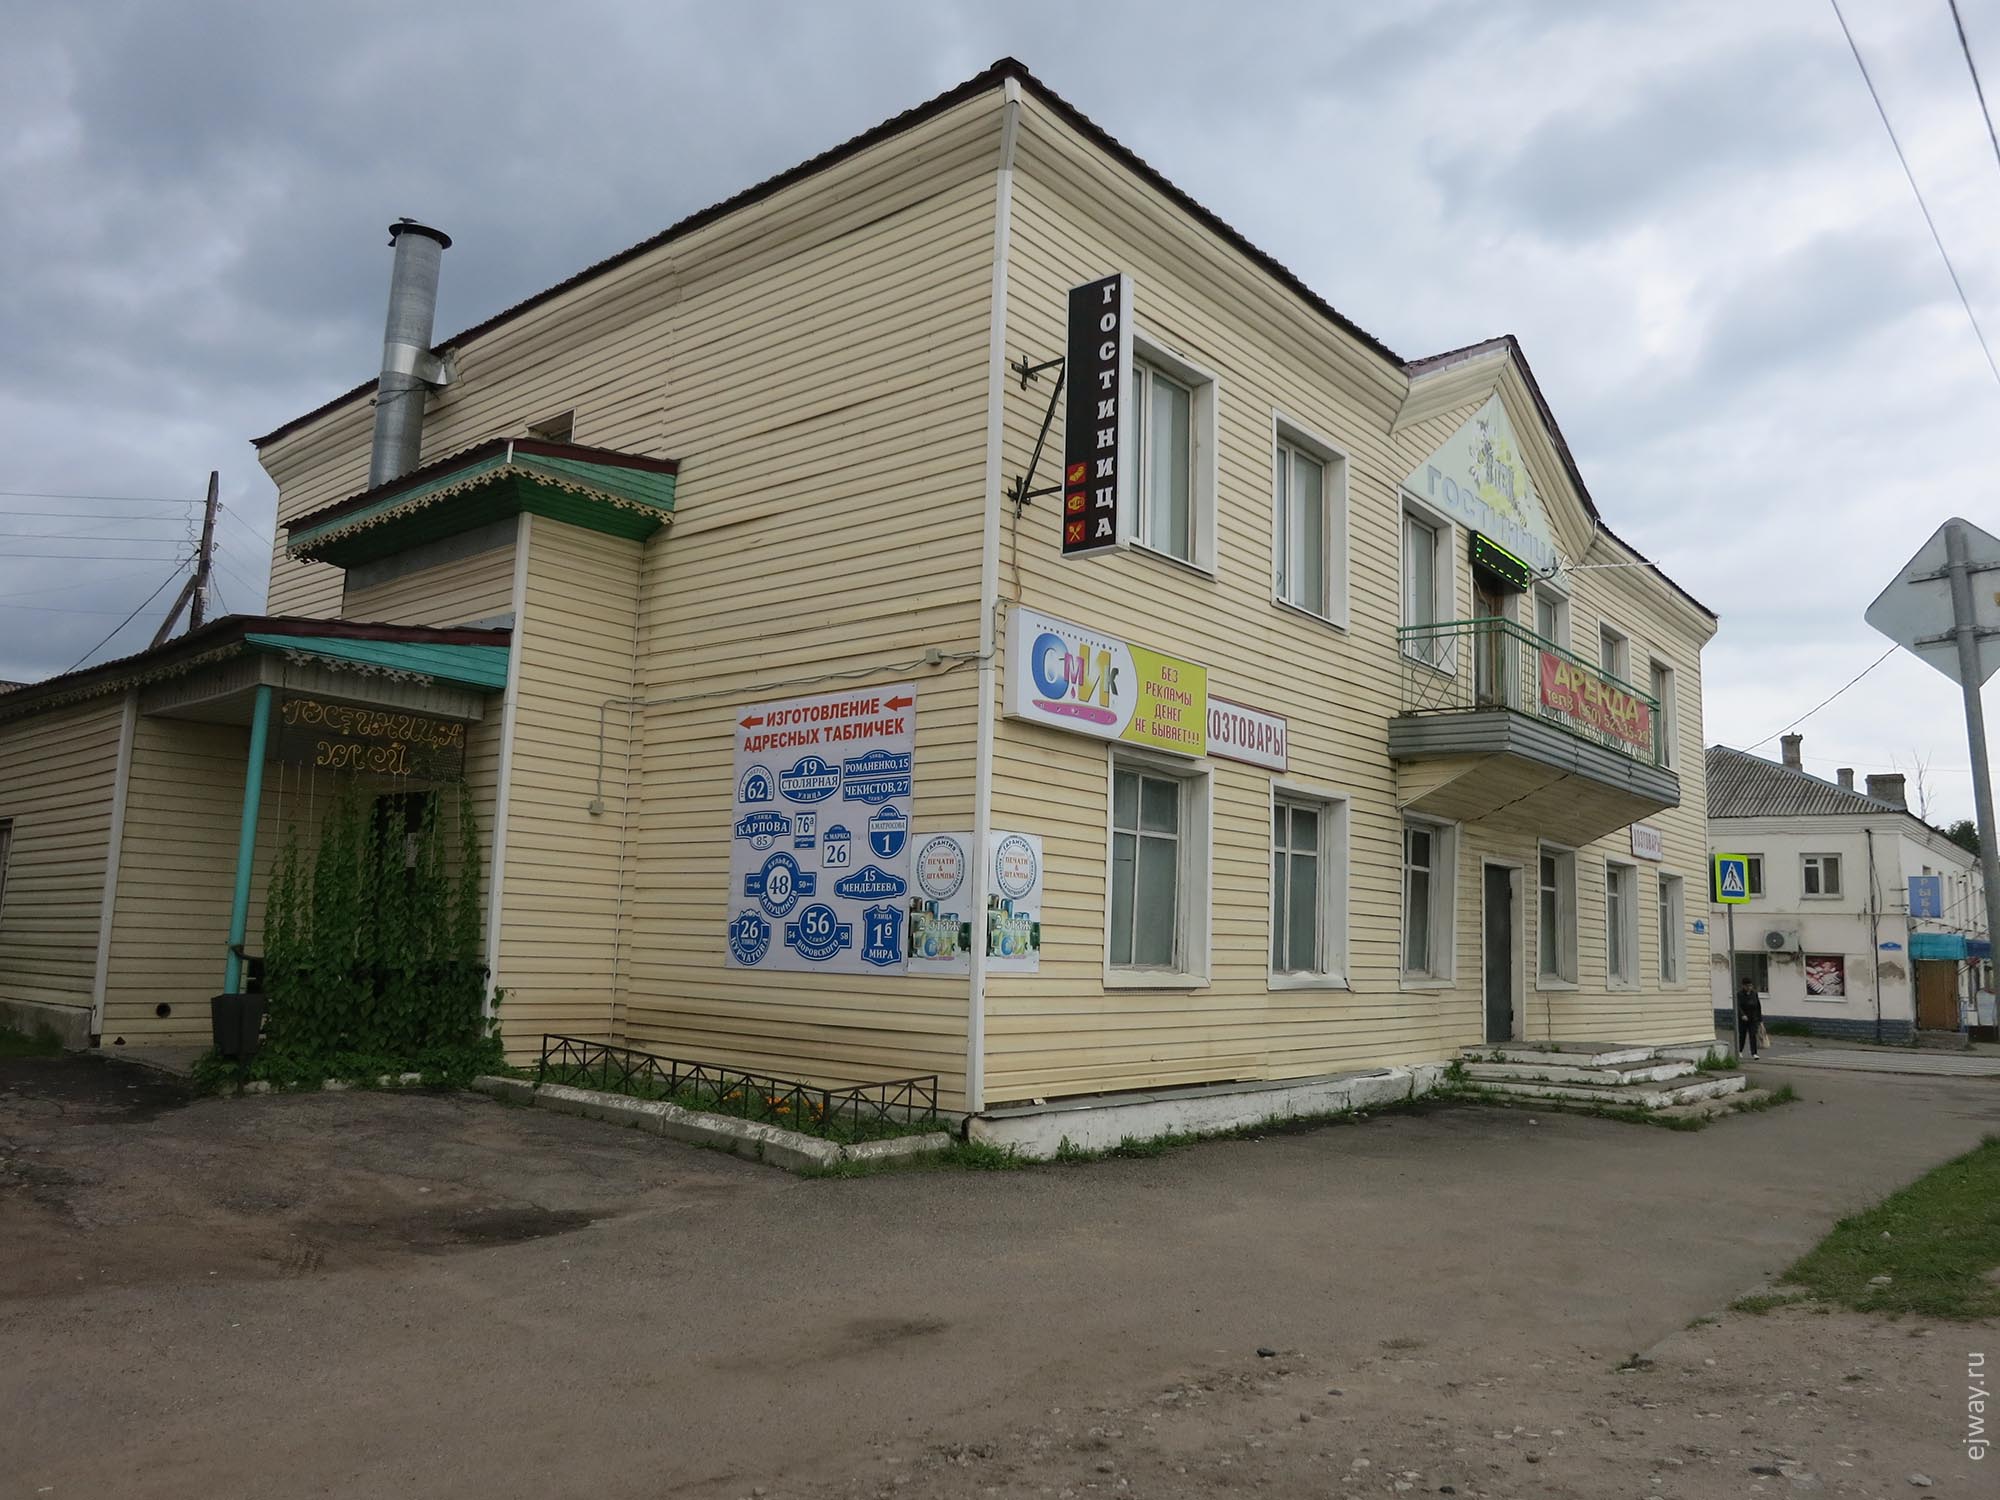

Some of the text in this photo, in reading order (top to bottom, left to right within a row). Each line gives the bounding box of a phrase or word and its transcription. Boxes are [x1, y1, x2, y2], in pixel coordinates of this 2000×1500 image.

[1095, 282, 1117, 539] ГОСТИНИЦА
[1161, 665, 1178, 683] БЕЗ
[1145, 681, 1192, 706] РЕКЛАМЫ
[1553, 660, 1639, 723] АРЕНДА
[766, 697, 880, 727] ИЗГОТОВЛЕНИЕ
[1154, 703, 1182, 722] ДЕНЕГ
[743, 717, 905, 753] АДРЕСНЫХ ТАБЛИЧЕК
[1135, 717, 1200, 745] НЕ БЫВАЕТ!!!
[801, 760, 817, 775] 19
[899, 758, 909, 768] 15
[747, 780, 765, 799] 62
[781, 775, 838, 790] СТОЛЯРНАЯ
[897, 780, 908, 791] 27
[738, 821, 788, 836] КАРПОВА
[756, 836, 768, 846] 85
[882, 834, 891, 853] 1
[926, 840, 956, 853] ГАРАНТИЯ
[826, 844, 846, 864] 26
[769, 875, 789, 895] 48
[864, 870, 876, 882] 15
[926, 872, 955, 880] ШТАМПЫ
[842, 882, 897, 894] МЕНДЕЛЕЕВА
[740, 920, 759, 939] 26
[806, 911, 830, 935] 56
[788, 930, 796, 939] 54
[730, 936, 768, 962] КУРЧАТОВА
[796, 939, 839, 957] ВОРОВСКОГО
[868, 949, 893, 959] МИРА
